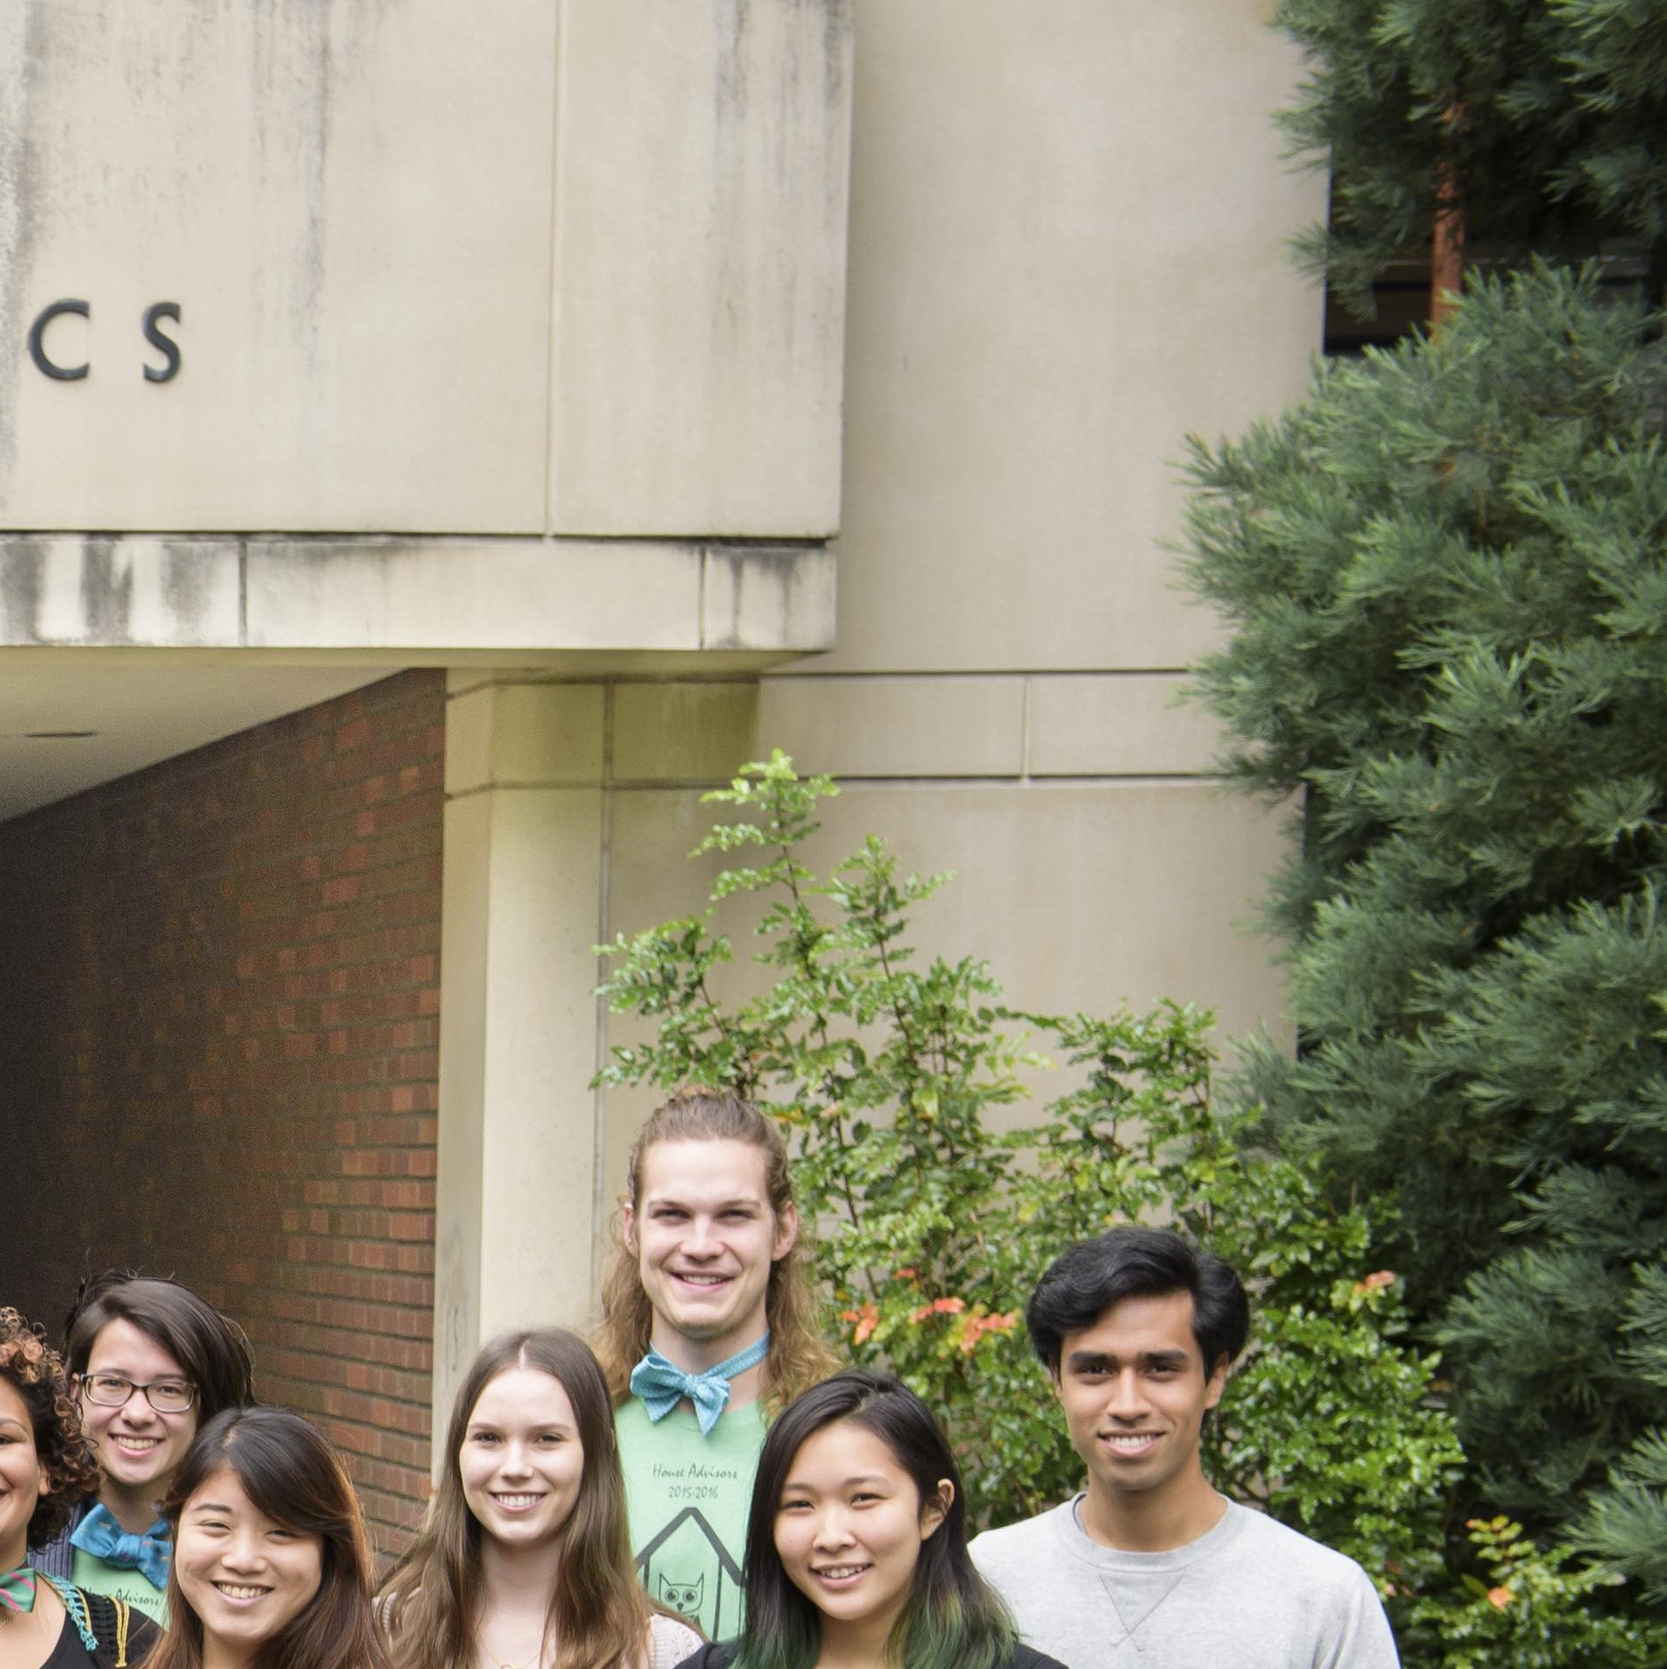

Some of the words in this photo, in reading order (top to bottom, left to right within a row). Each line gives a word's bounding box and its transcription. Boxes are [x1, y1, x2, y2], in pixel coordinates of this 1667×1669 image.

[652, 1463, 684, 1478] House
[687, 1462, 738, 1479] Advisors
[668, 1485, 719, 1499] 2015-2016
